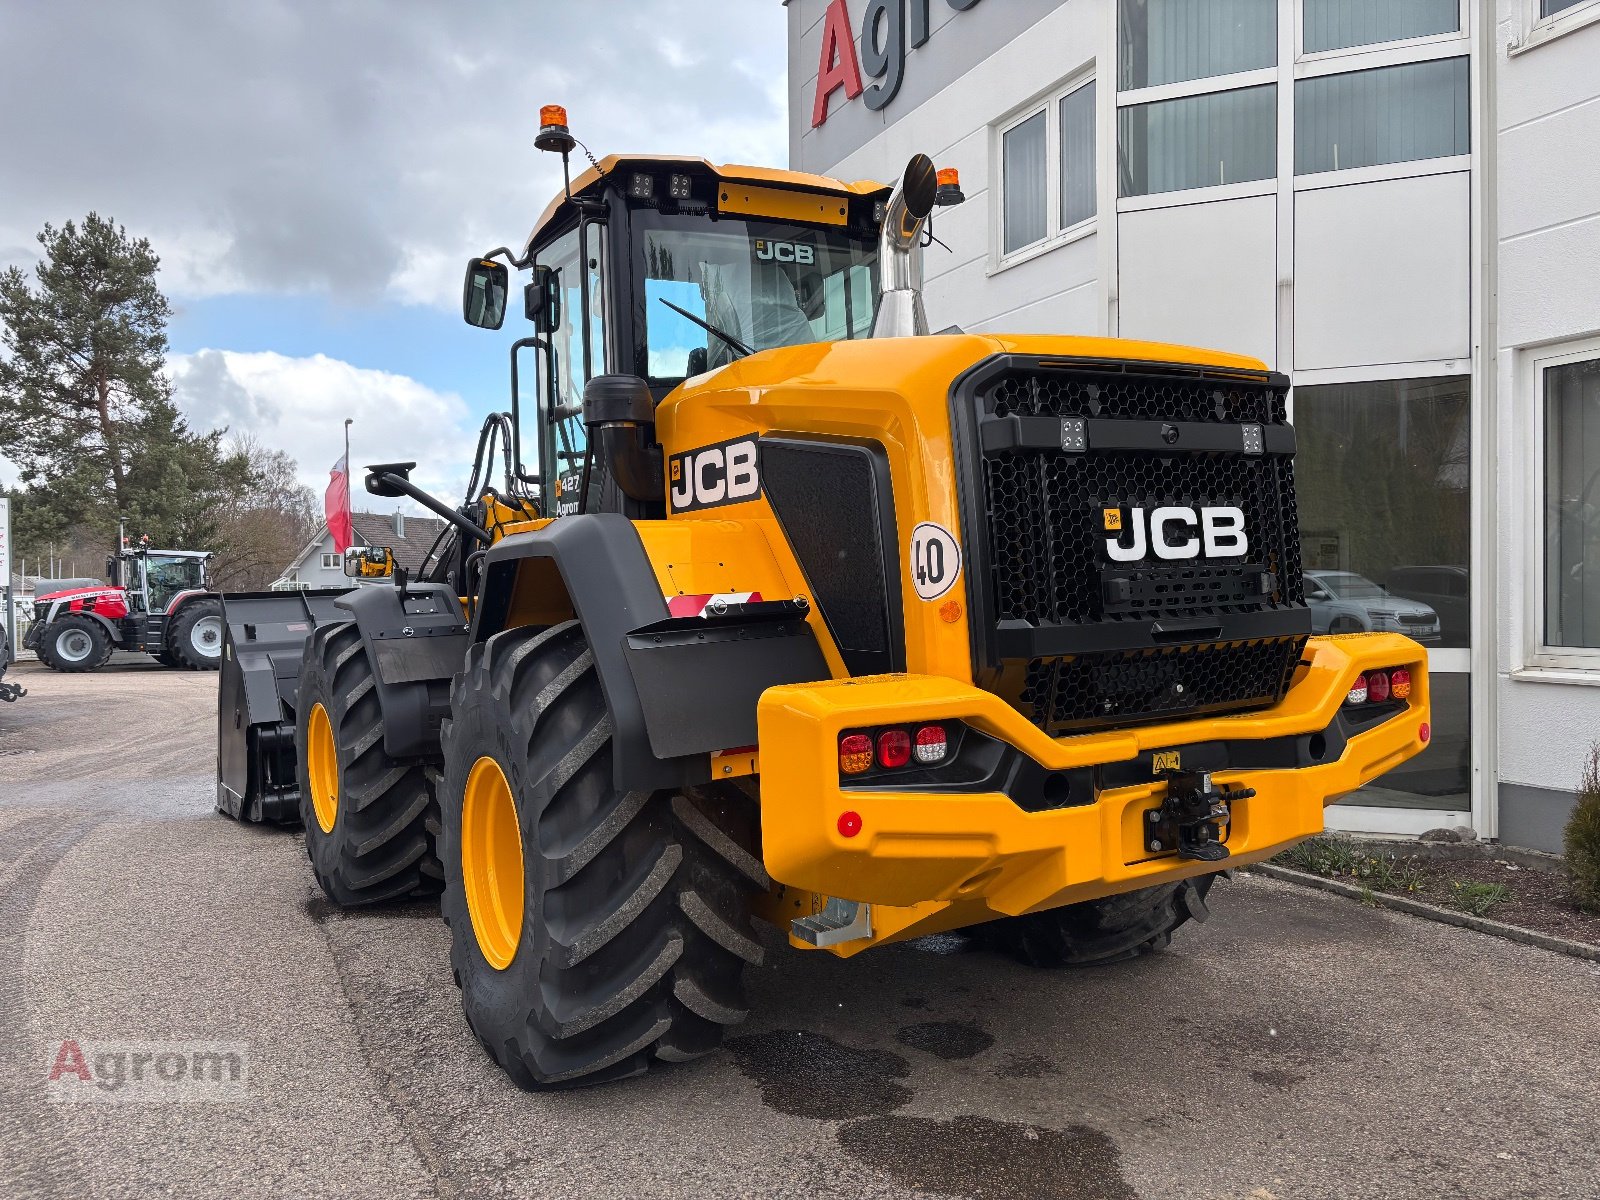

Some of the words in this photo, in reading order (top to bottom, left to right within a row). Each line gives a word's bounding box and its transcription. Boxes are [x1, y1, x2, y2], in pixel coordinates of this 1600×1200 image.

[757, 241, 814, 264] JCB
[672, 440, 759, 508] JCB
[1105, 506, 1249, 562] JCB
[915, 537, 945, 586] 40
